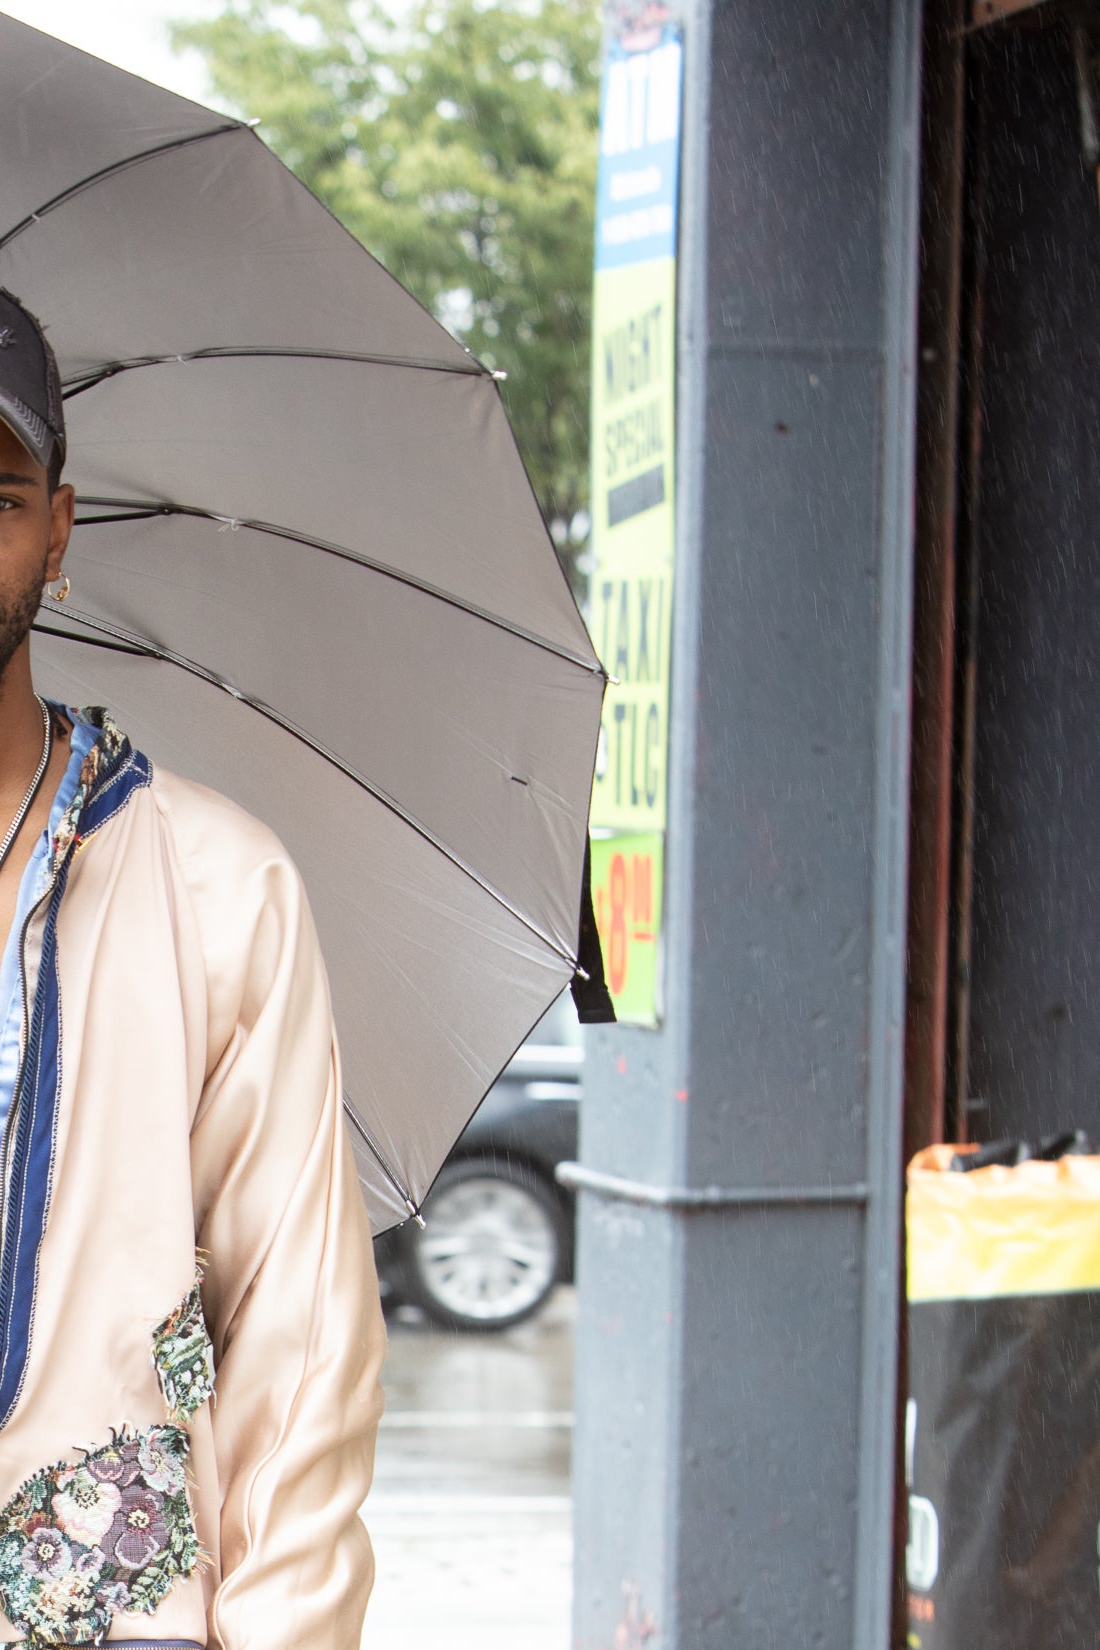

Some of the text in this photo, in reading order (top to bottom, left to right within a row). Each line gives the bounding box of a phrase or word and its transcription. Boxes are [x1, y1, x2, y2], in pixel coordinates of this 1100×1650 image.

[603, 304, 663, 402] NIGHT
[604, 399, 664, 478] SPECIAL
[601, 577, 664, 682] TAXI
